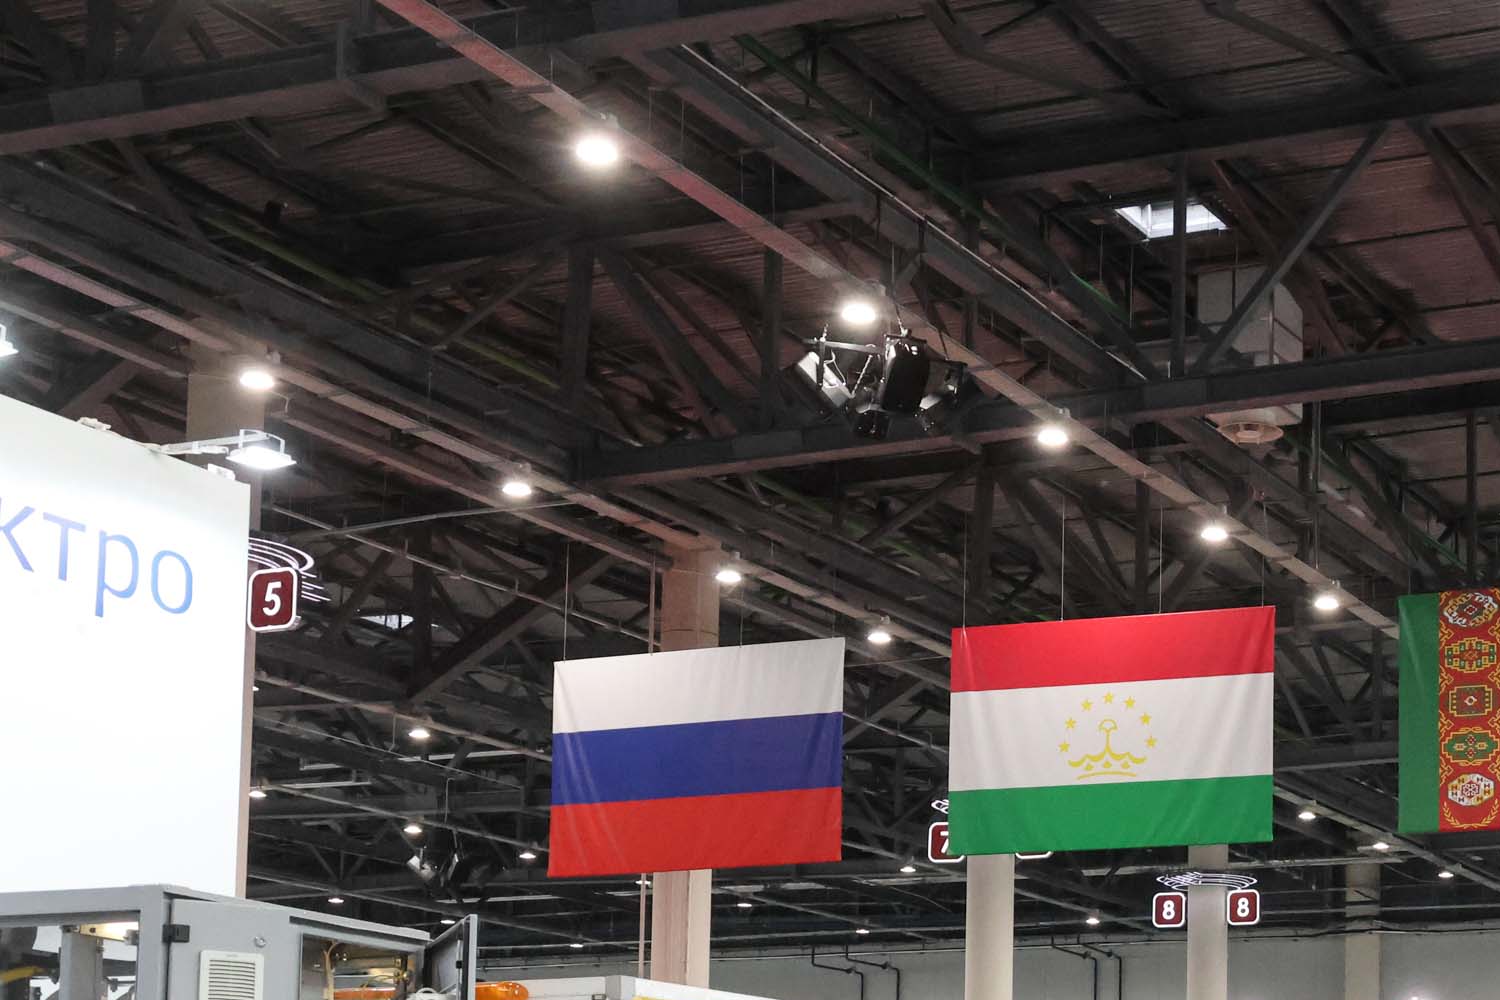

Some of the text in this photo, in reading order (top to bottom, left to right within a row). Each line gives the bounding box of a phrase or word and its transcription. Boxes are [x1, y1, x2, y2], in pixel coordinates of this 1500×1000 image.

[262, 580, 282, 616] 5
[1162, 900, 1176, 920] 8
[1236, 897, 1250, 918] 8
